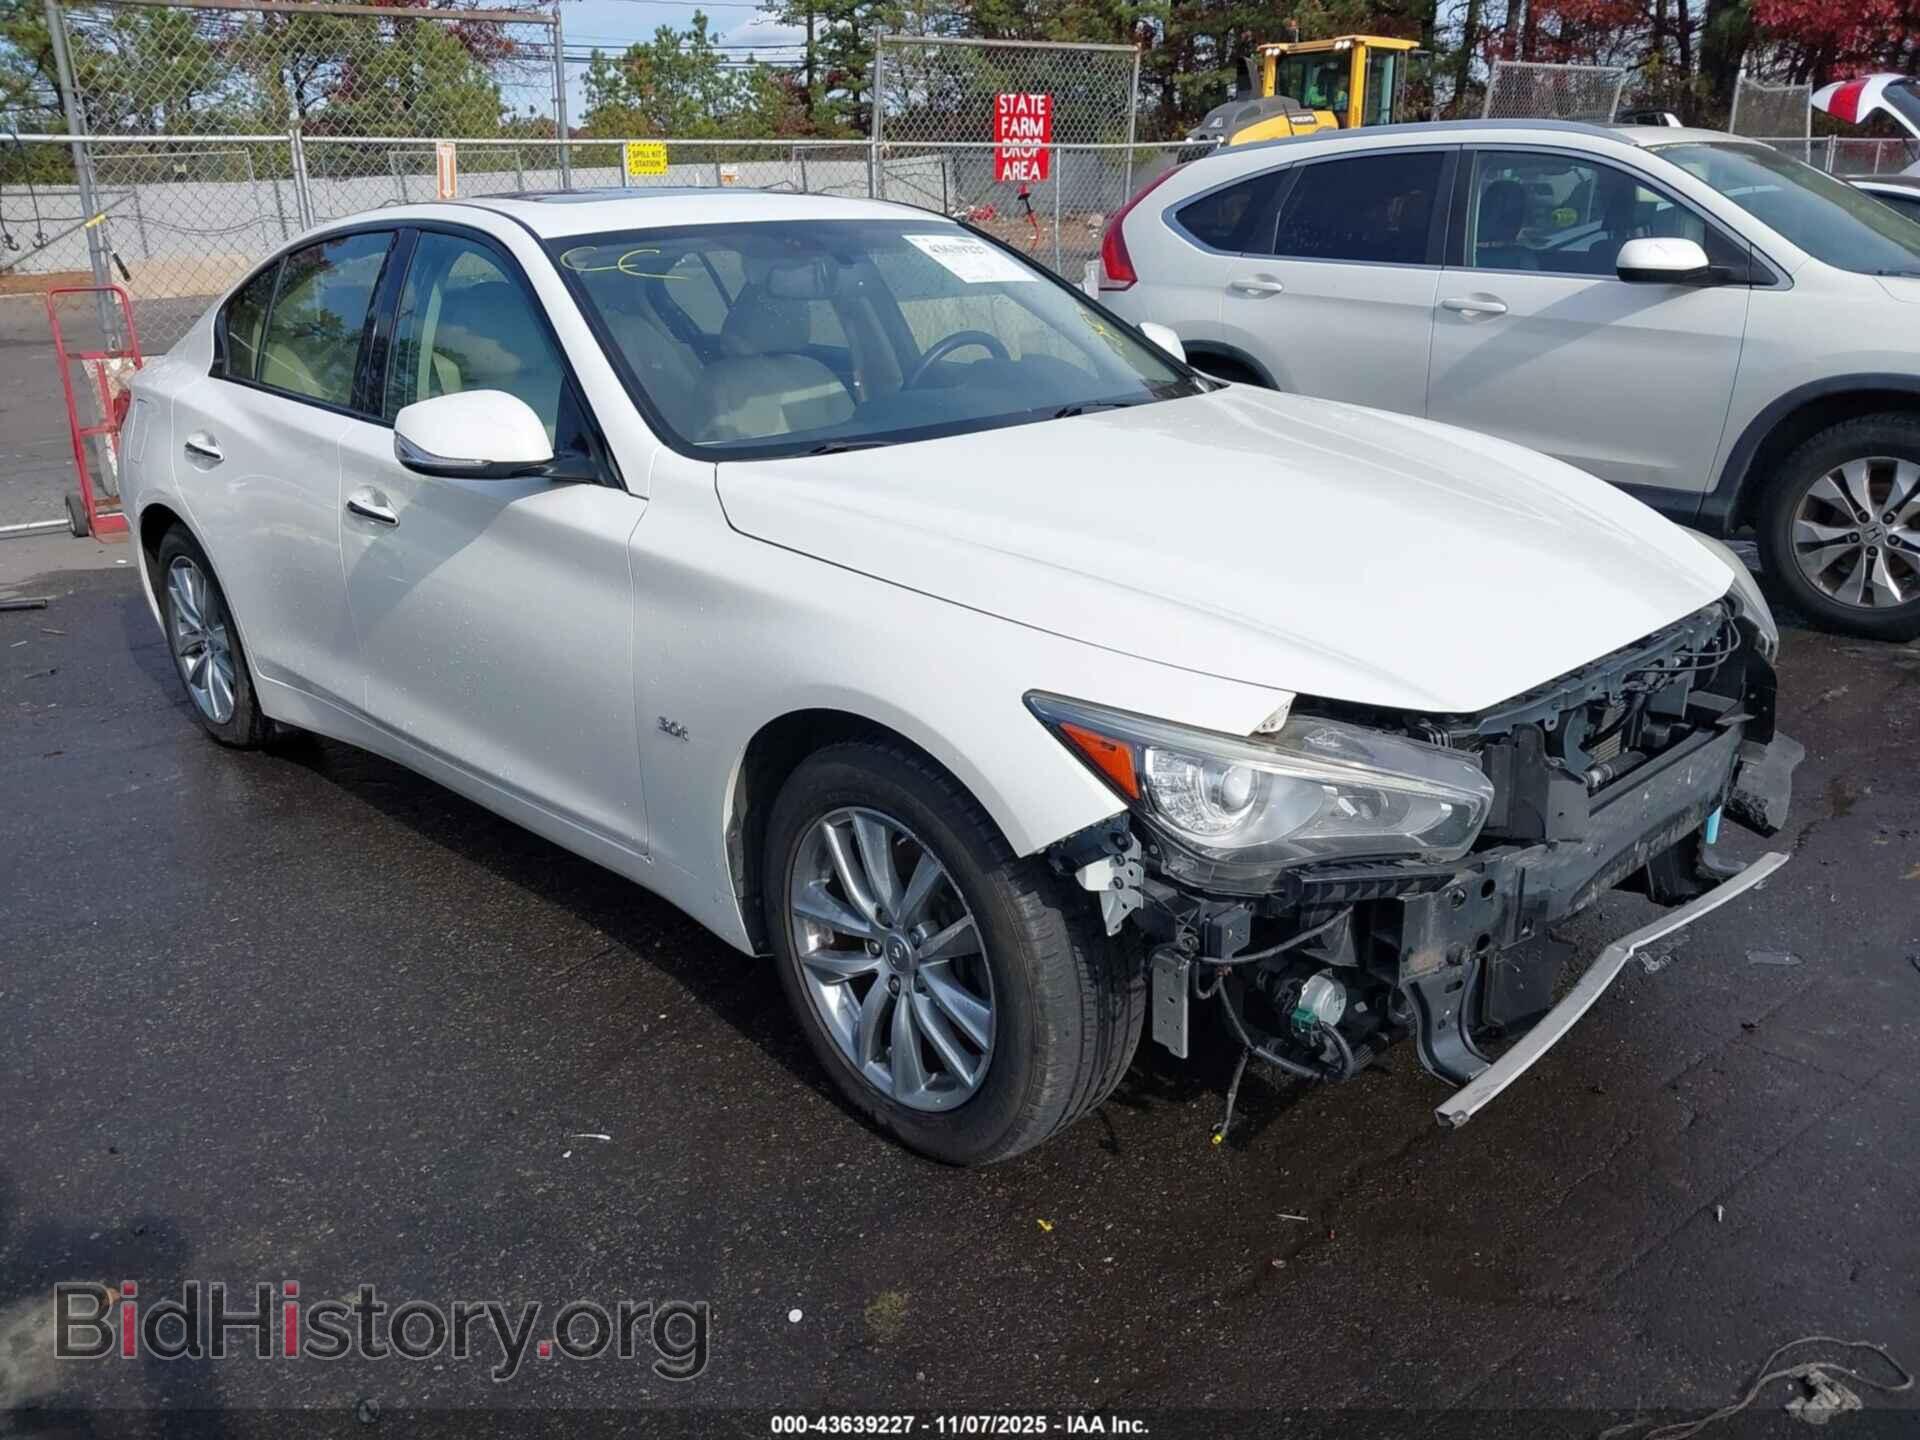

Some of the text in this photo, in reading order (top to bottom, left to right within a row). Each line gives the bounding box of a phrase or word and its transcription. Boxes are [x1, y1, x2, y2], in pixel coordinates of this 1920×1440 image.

[999, 94, 1046, 114] STATE
[1001, 116, 1044, 136] FARM
[1002, 138, 1042, 158] DROP
[1002, 161, 1041, 181] AREA
